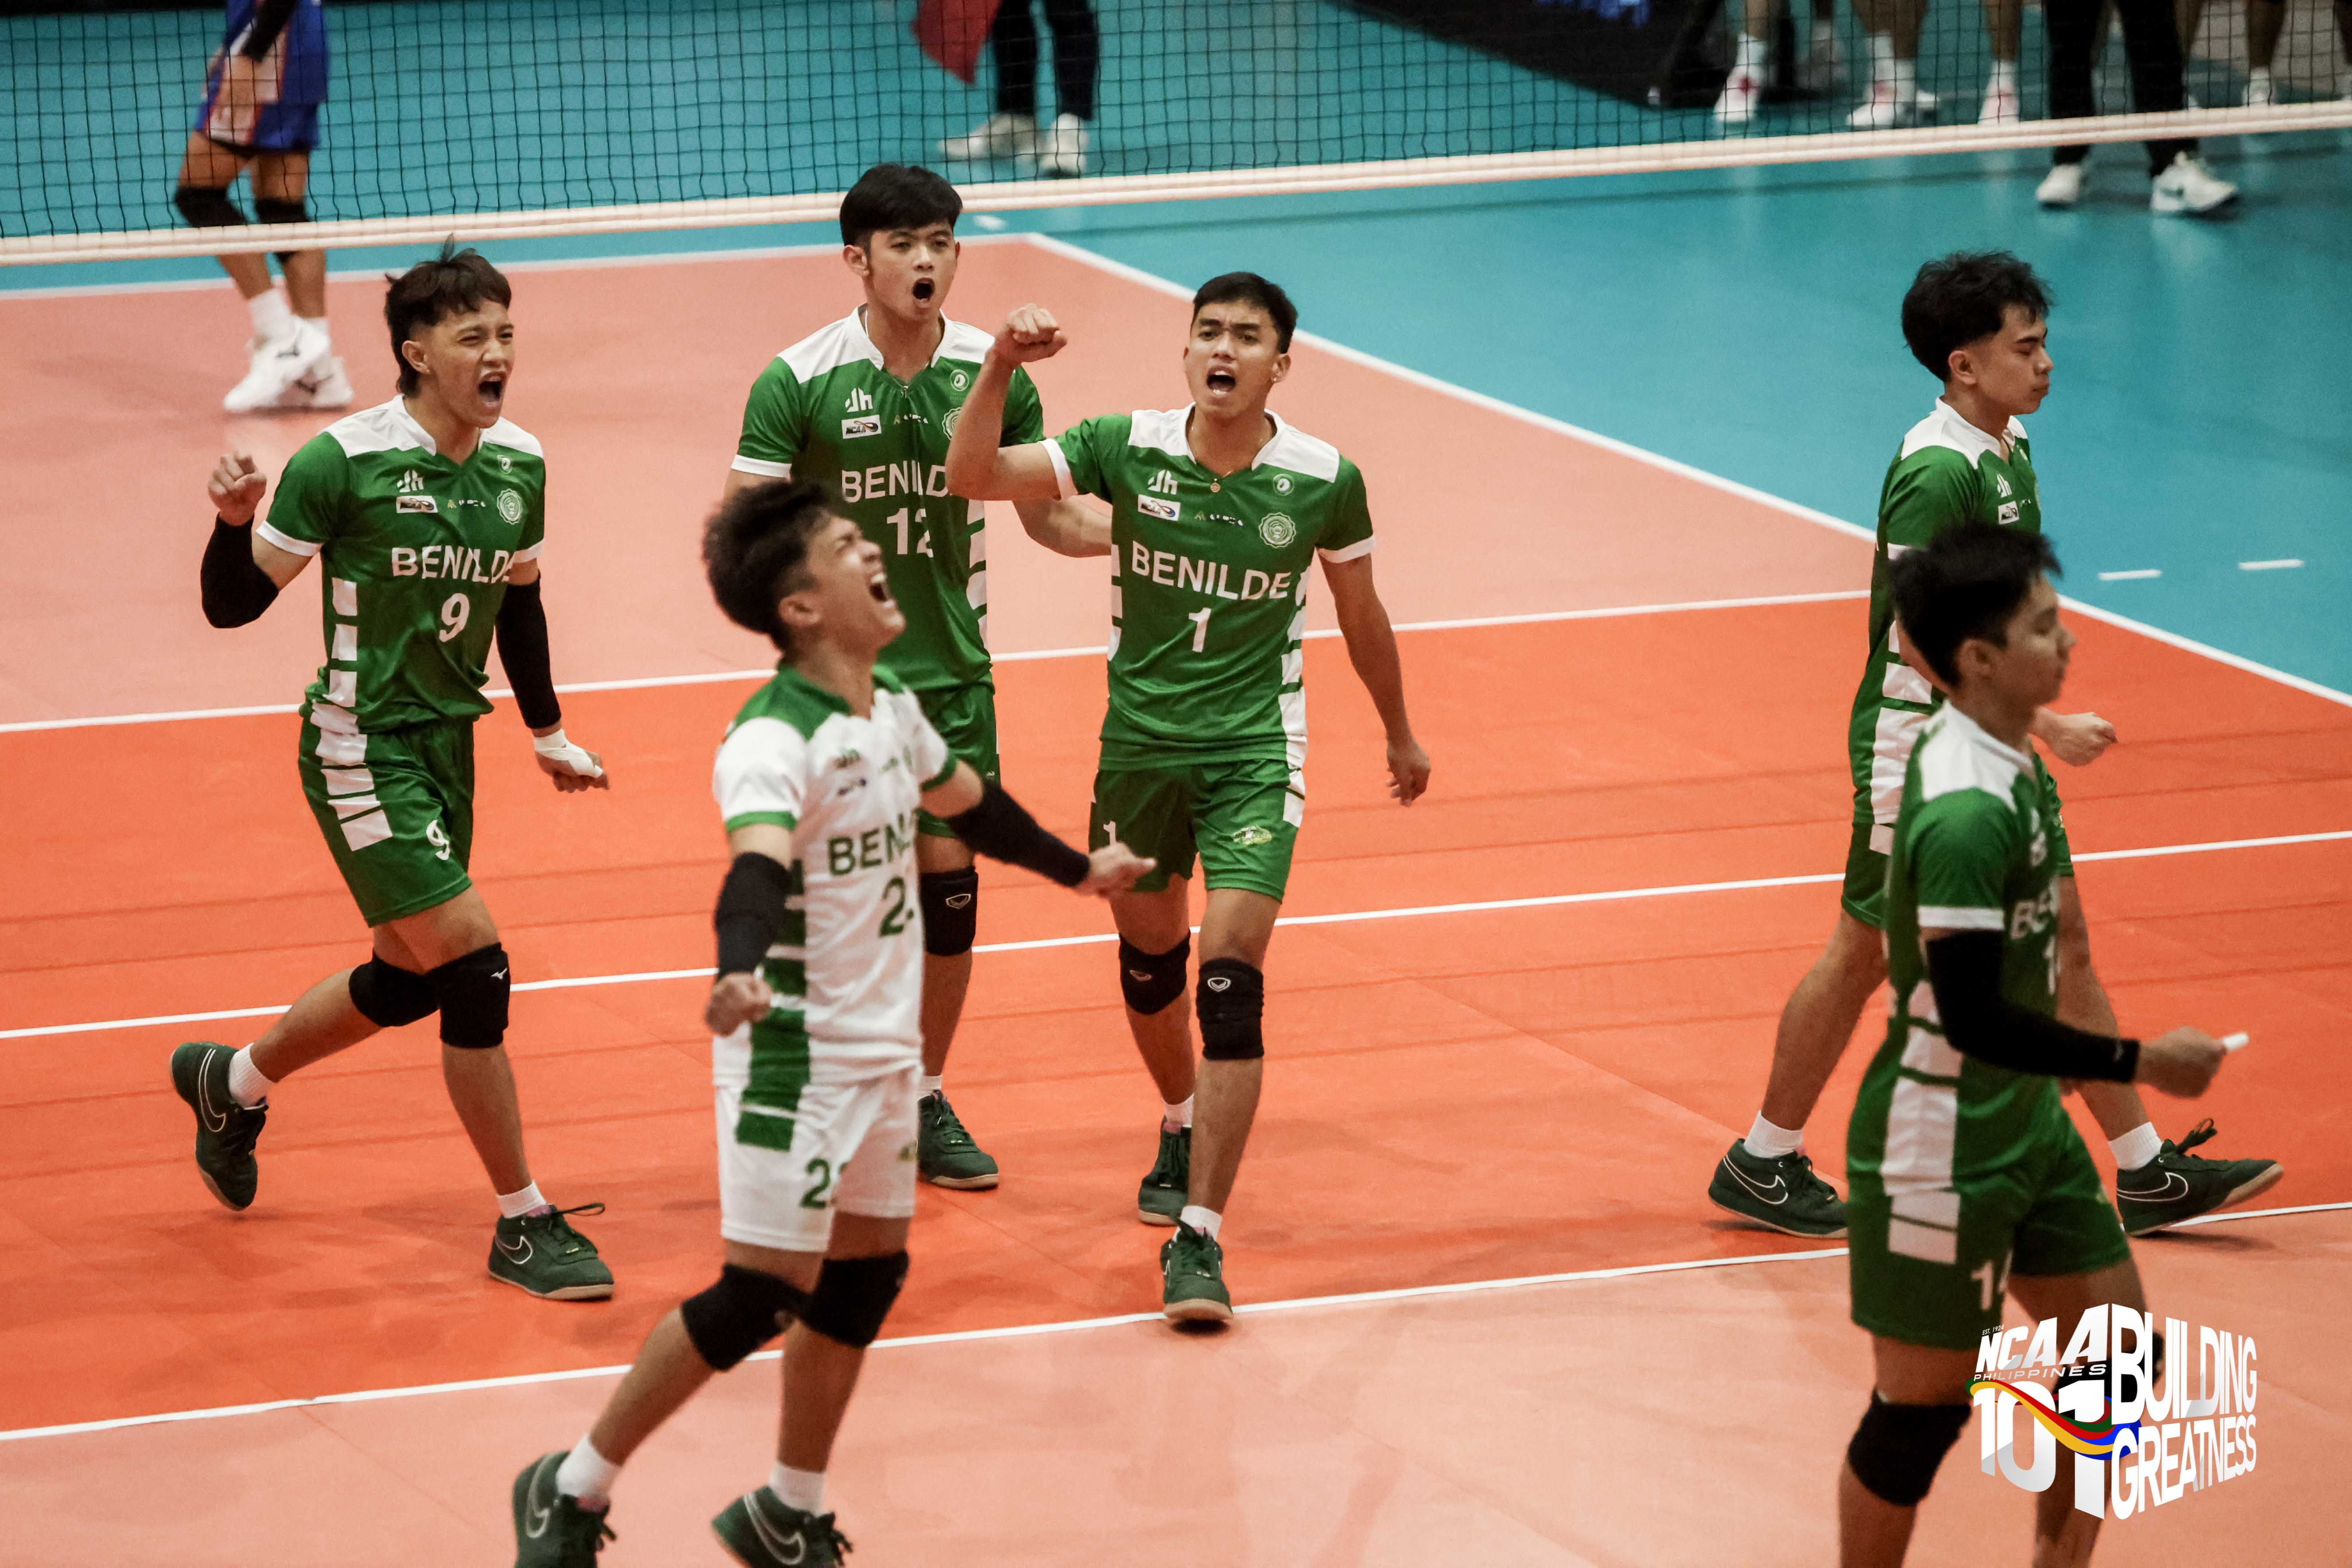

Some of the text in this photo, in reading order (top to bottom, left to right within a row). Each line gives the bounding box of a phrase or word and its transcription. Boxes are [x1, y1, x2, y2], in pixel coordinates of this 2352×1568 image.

[1132, 540, 1292, 600] BENILDE
[439, 593, 470, 642] 9
[1188, 607, 1211, 652] 1
[426, 819, 450, 860] 9
[1103, 821, 1116, 845] 1
